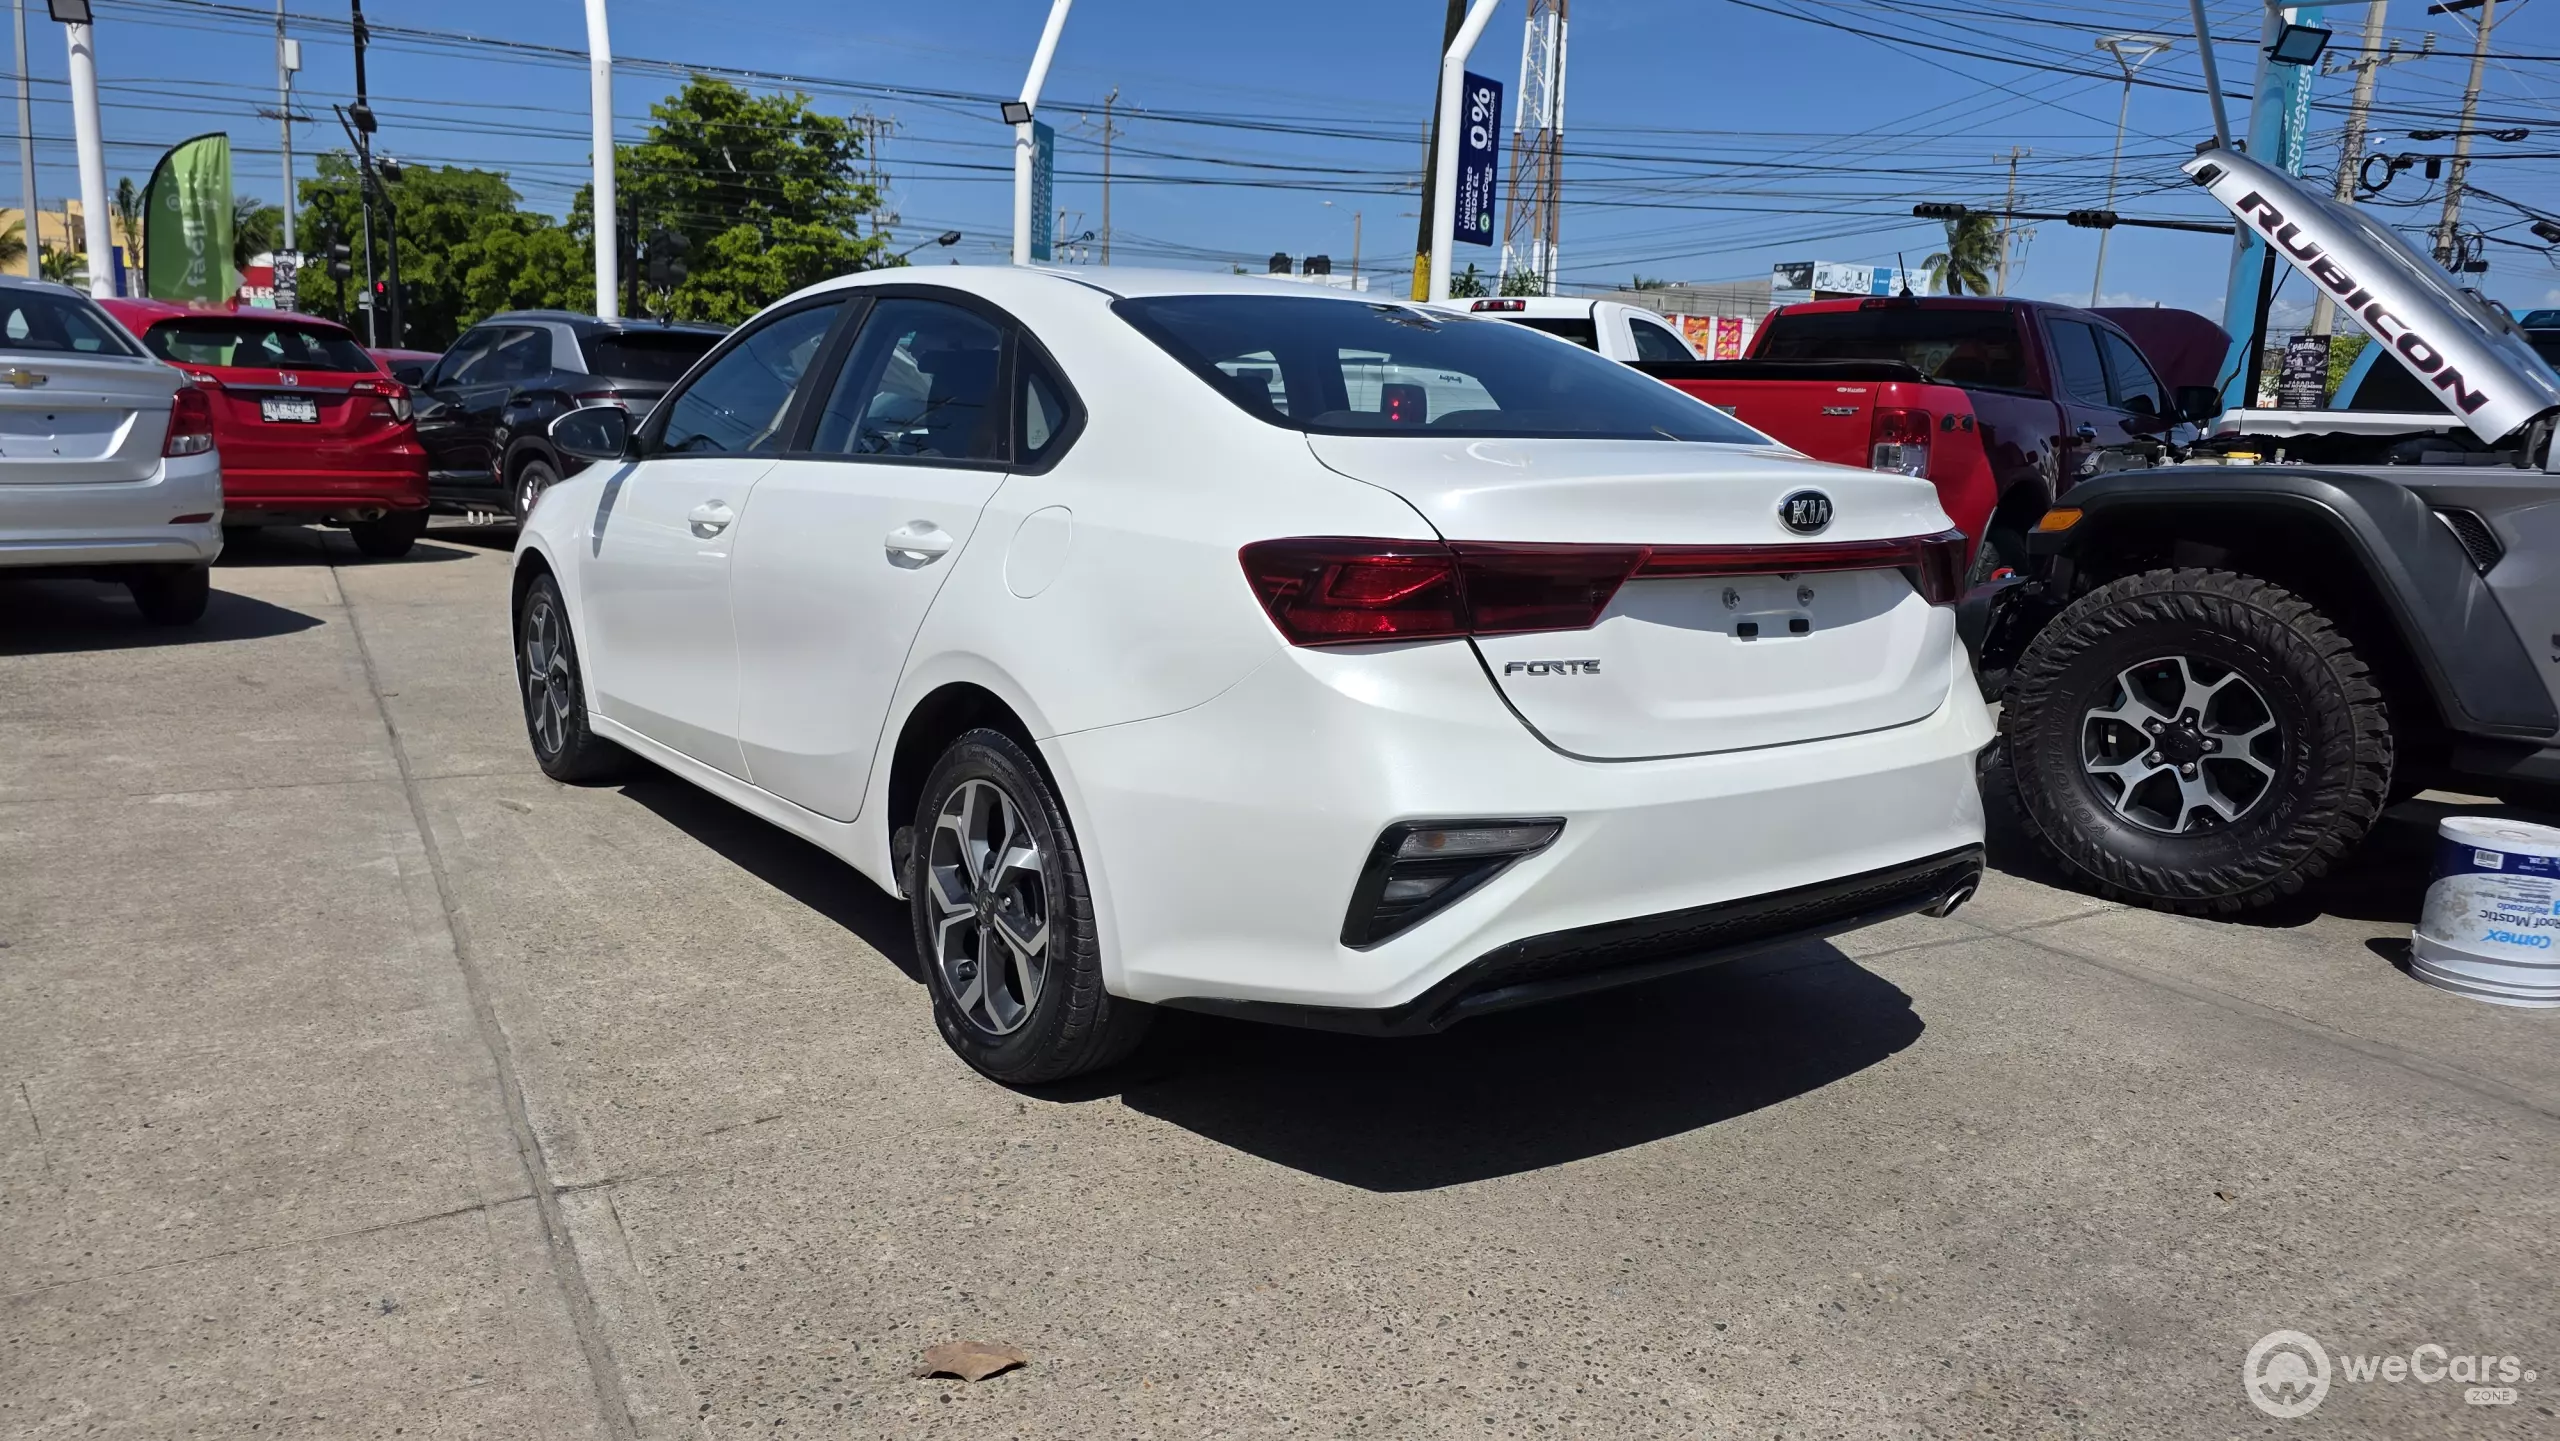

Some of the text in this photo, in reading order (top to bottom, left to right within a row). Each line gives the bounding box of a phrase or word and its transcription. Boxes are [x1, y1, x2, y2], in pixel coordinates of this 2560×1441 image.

[1470, 87, 1491, 150] 0%
[1487, 91, 1496, 152] DE ENGANCHE
[1463, 166, 1473, 230] UNIDADES
[1470, 172, 1479, 231] DESDE EL
[2236, 190, 2490, 416] RUBICON
[1791, 499, 1829, 524] KIA
[1503, 658, 1601, 677] FORTE
[2046, 689, 2110, 839] YOKOHAMA
[2480, 910, 2560, 929] Roof Mastic
[2497, 902, 2548, 915] Reforzado
[2480, 928, 2552, 949] Comex
